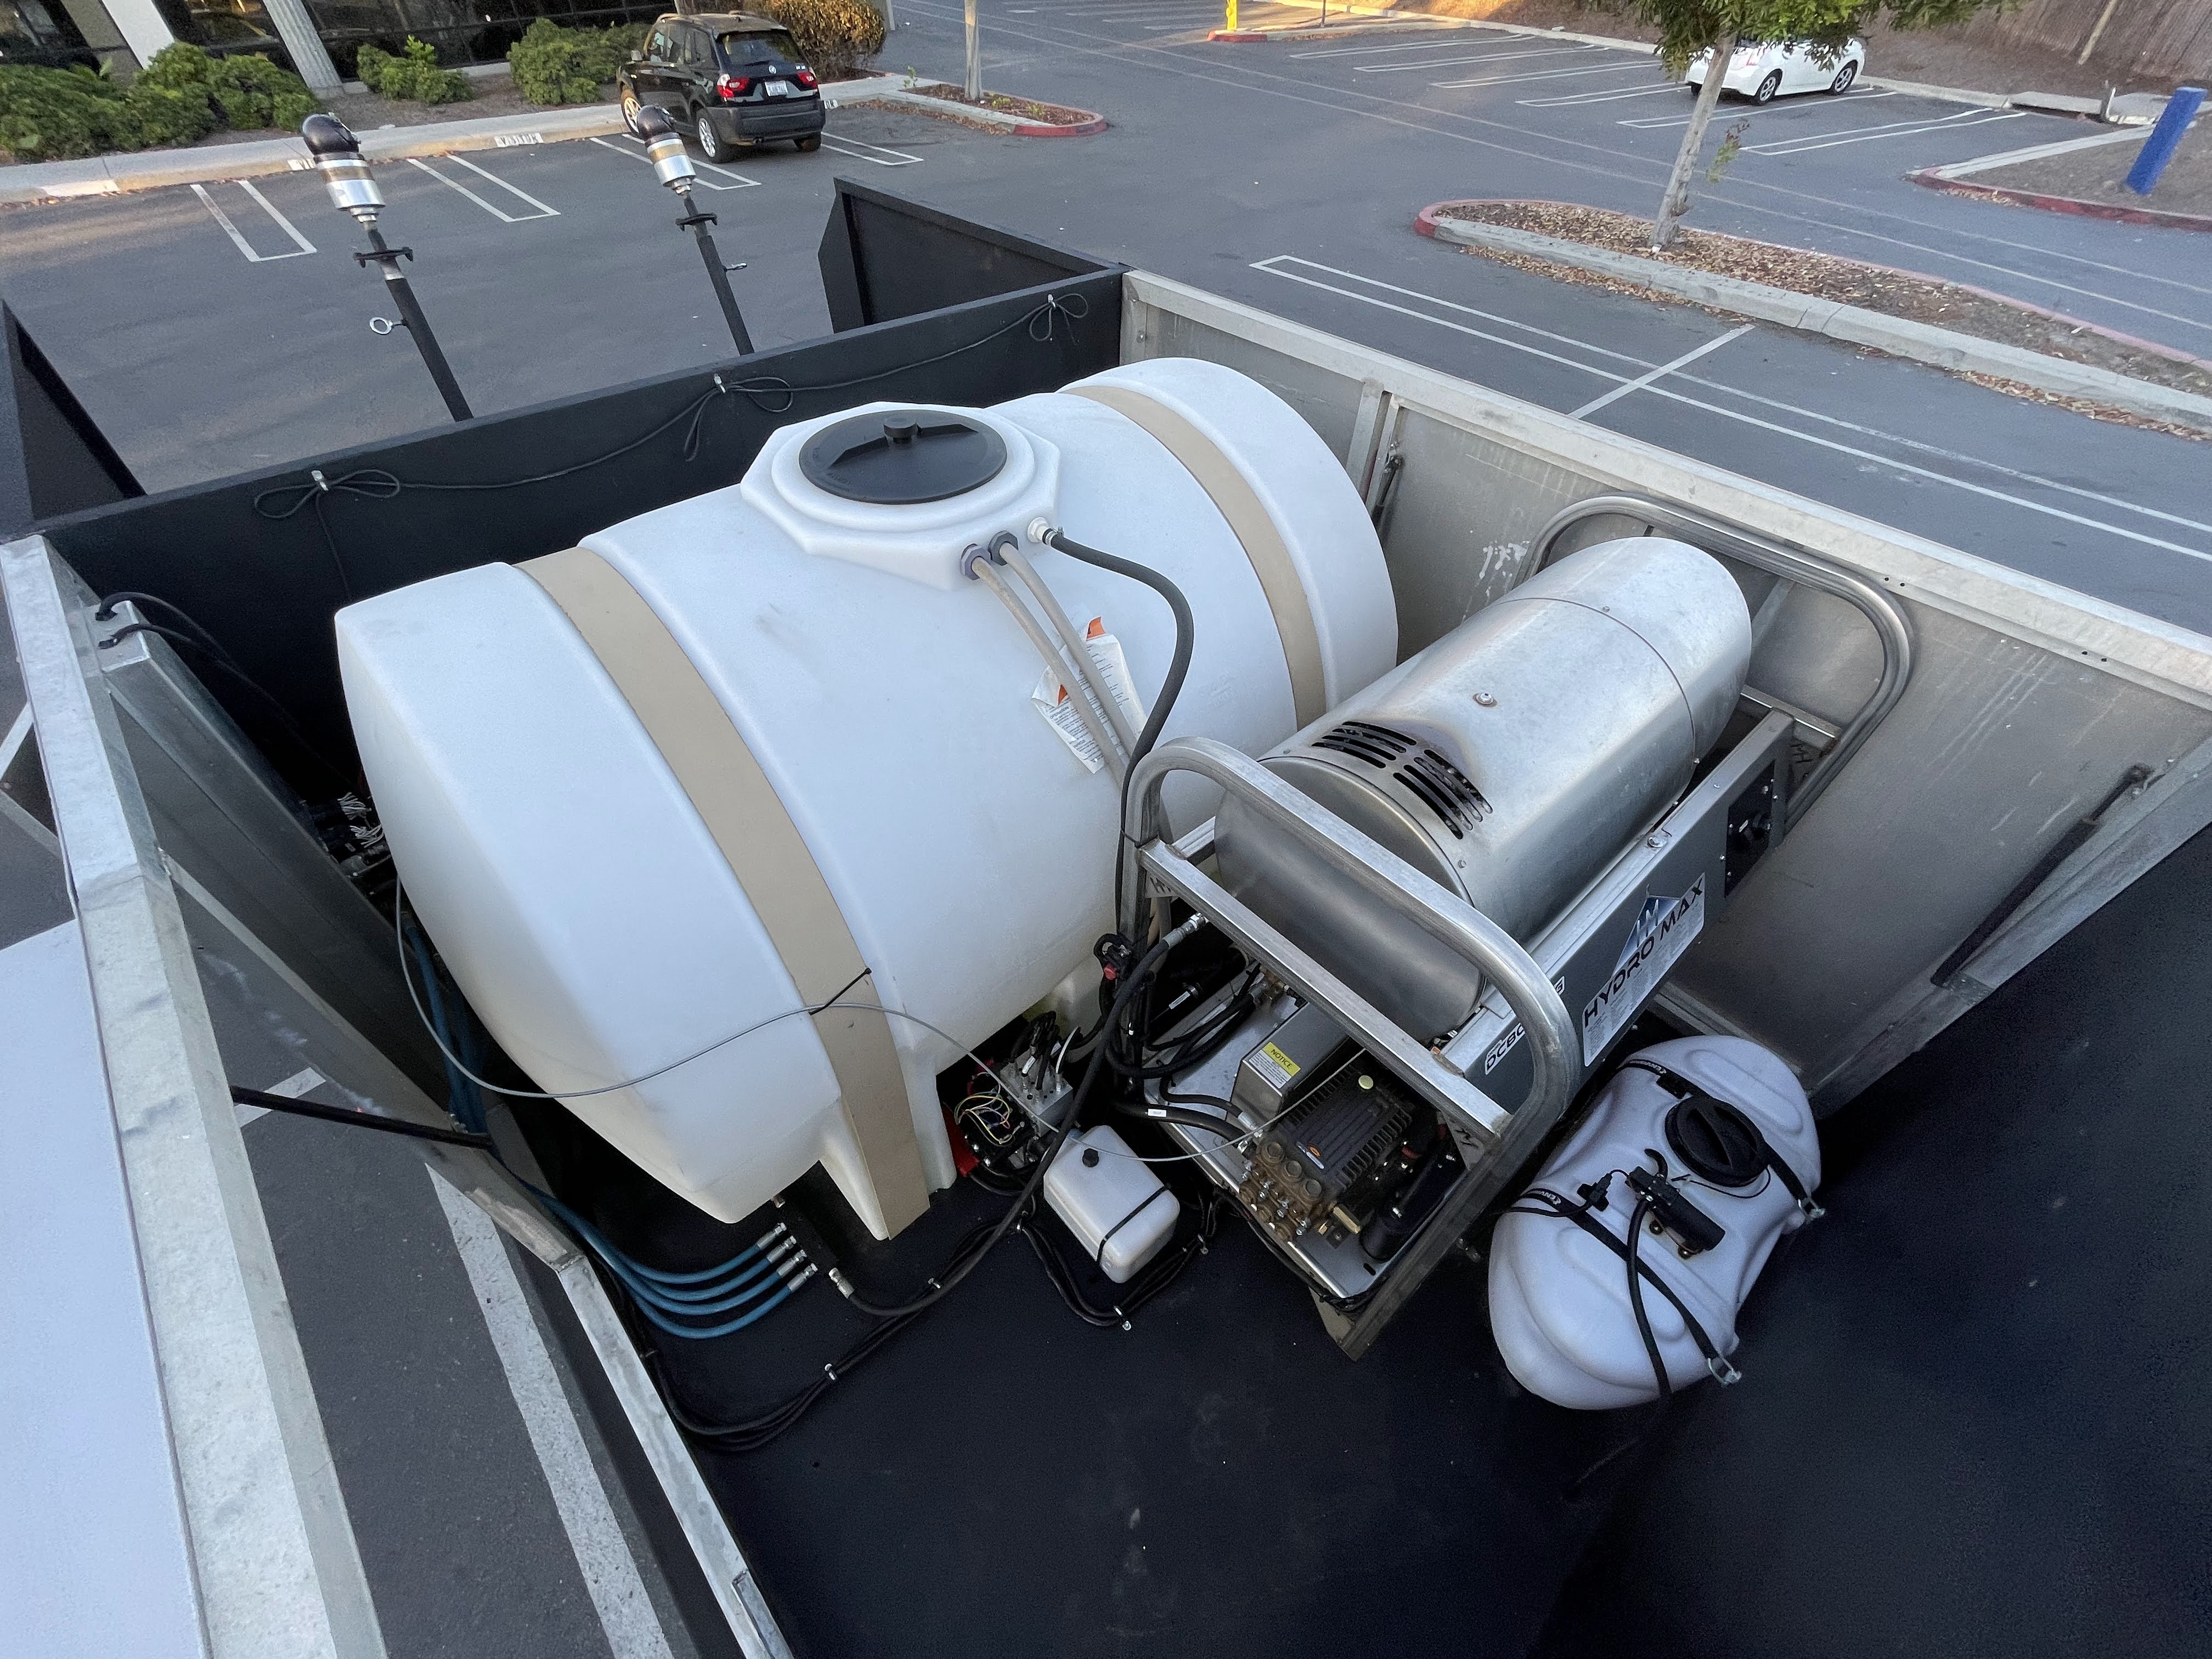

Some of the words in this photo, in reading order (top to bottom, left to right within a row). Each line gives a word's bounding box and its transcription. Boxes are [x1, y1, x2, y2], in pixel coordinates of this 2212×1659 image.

[1584, 936, 1655, 1028] HYDRO
[1661, 878, 1703, 940] MAX
[1271, 1049, 1292, 1068] NOTICE
